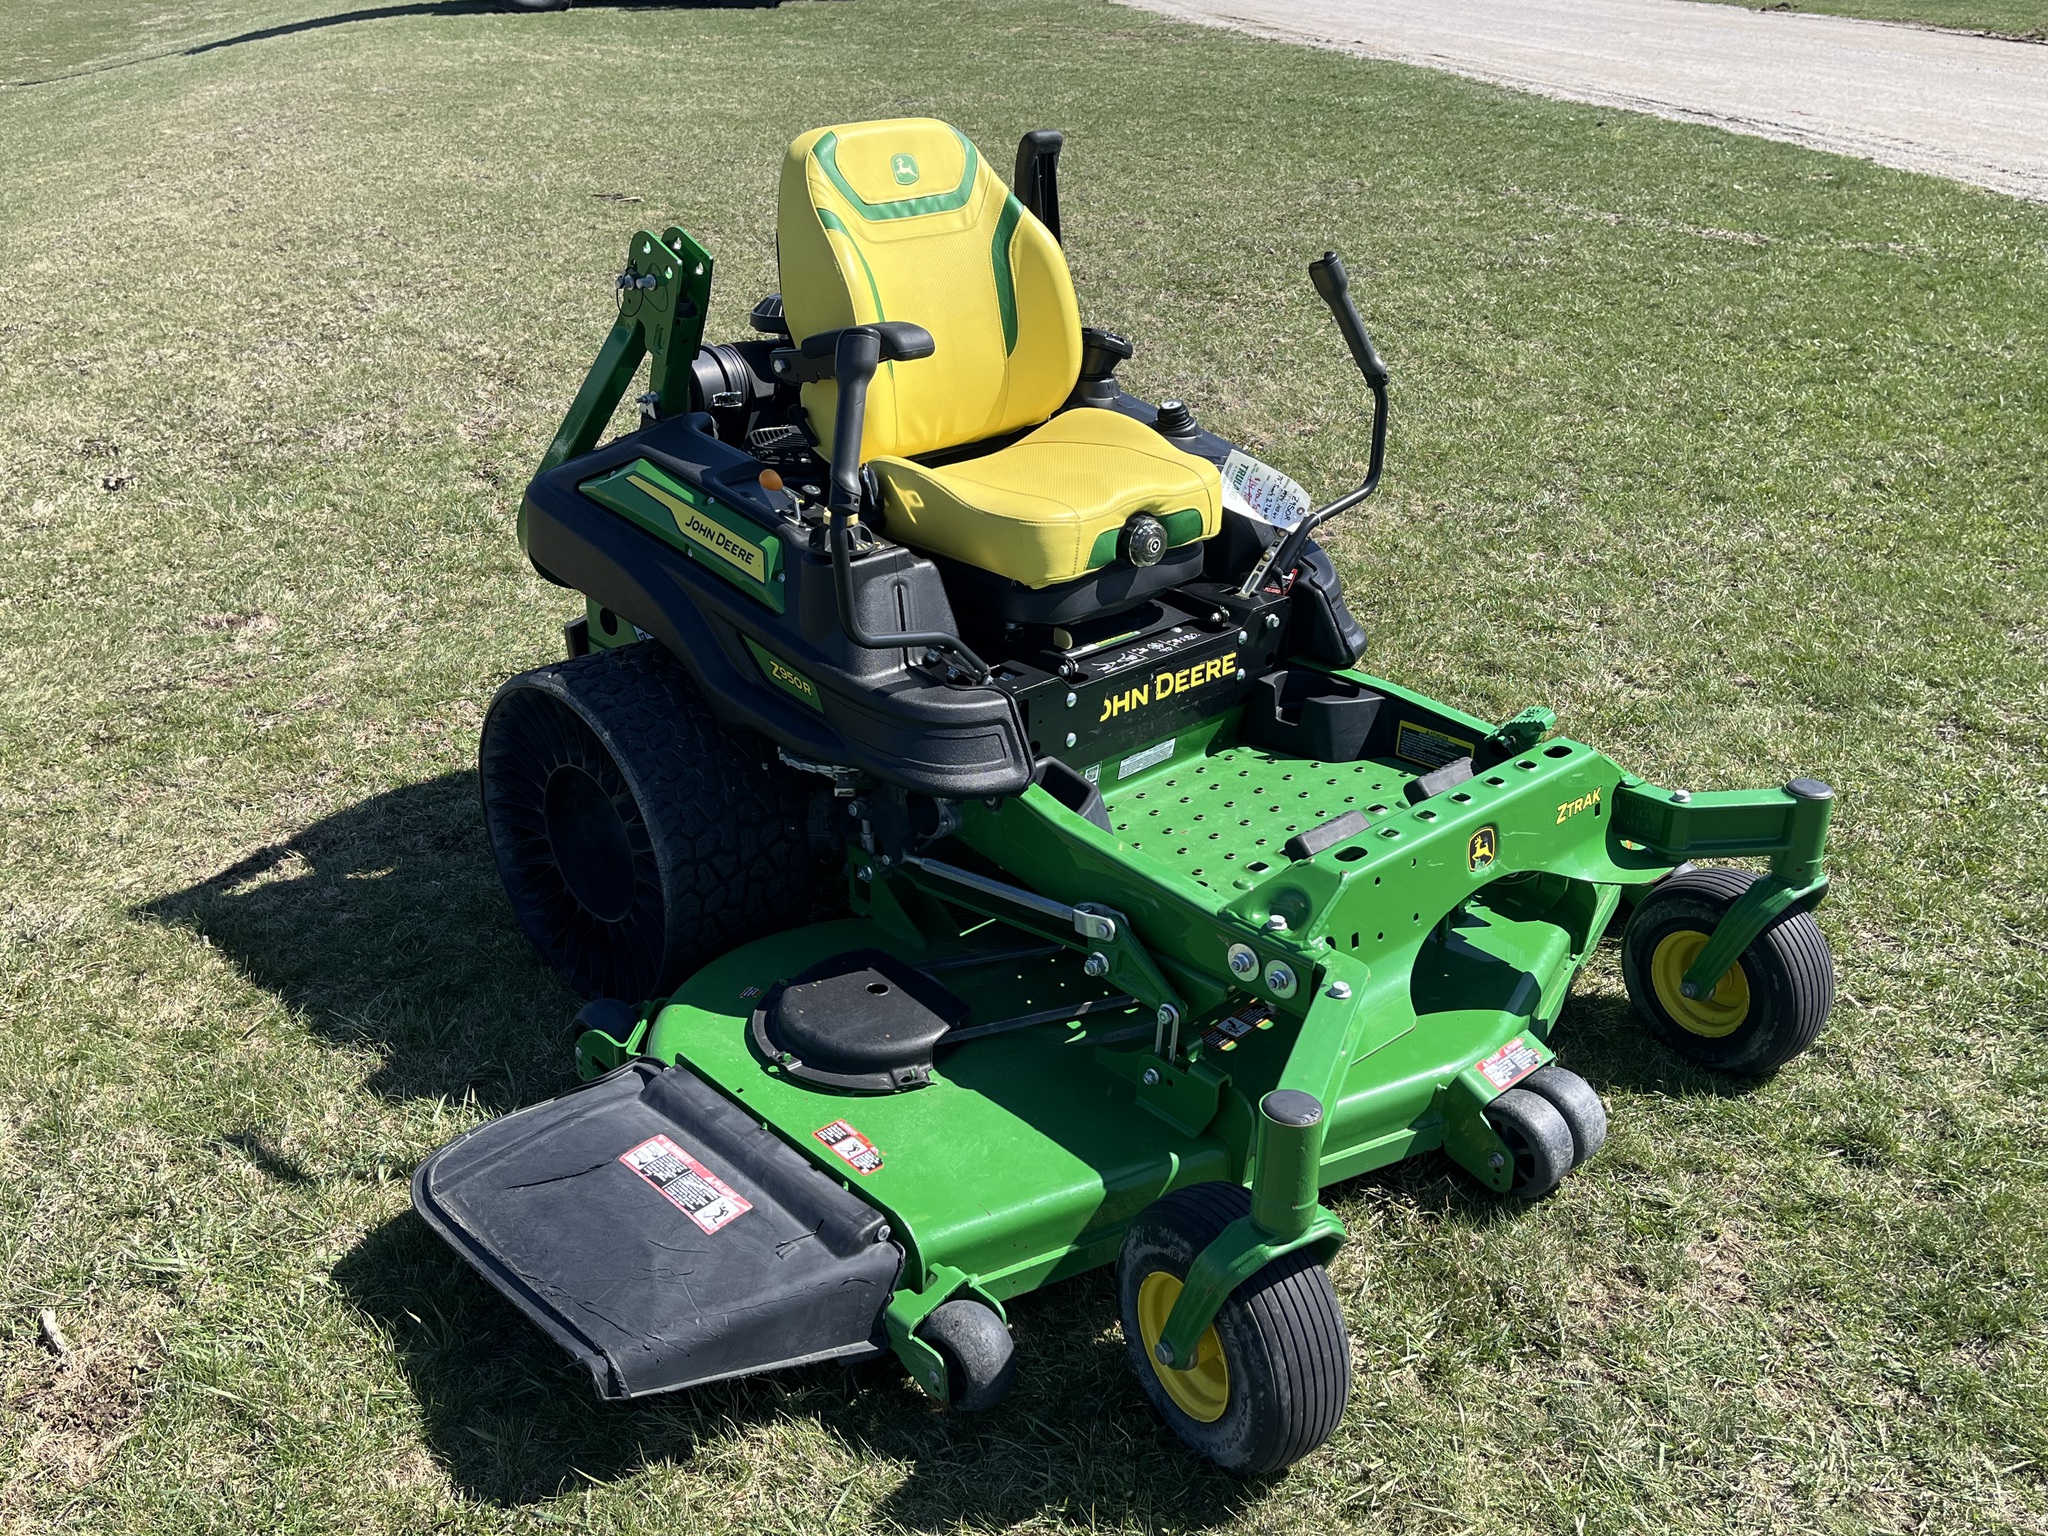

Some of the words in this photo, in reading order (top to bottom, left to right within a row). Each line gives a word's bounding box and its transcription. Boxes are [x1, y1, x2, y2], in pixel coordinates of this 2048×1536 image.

[685, 515, 716, 542] JOHN
[715, 533, 755, 565] DEERE
[769, 660, 812, 696] Z950R
[1099, 683, 1149, 722] OHN
[1155, 652, 1237, 701] DEERE
[1556, 786, 1602, 826] ZTRAK
